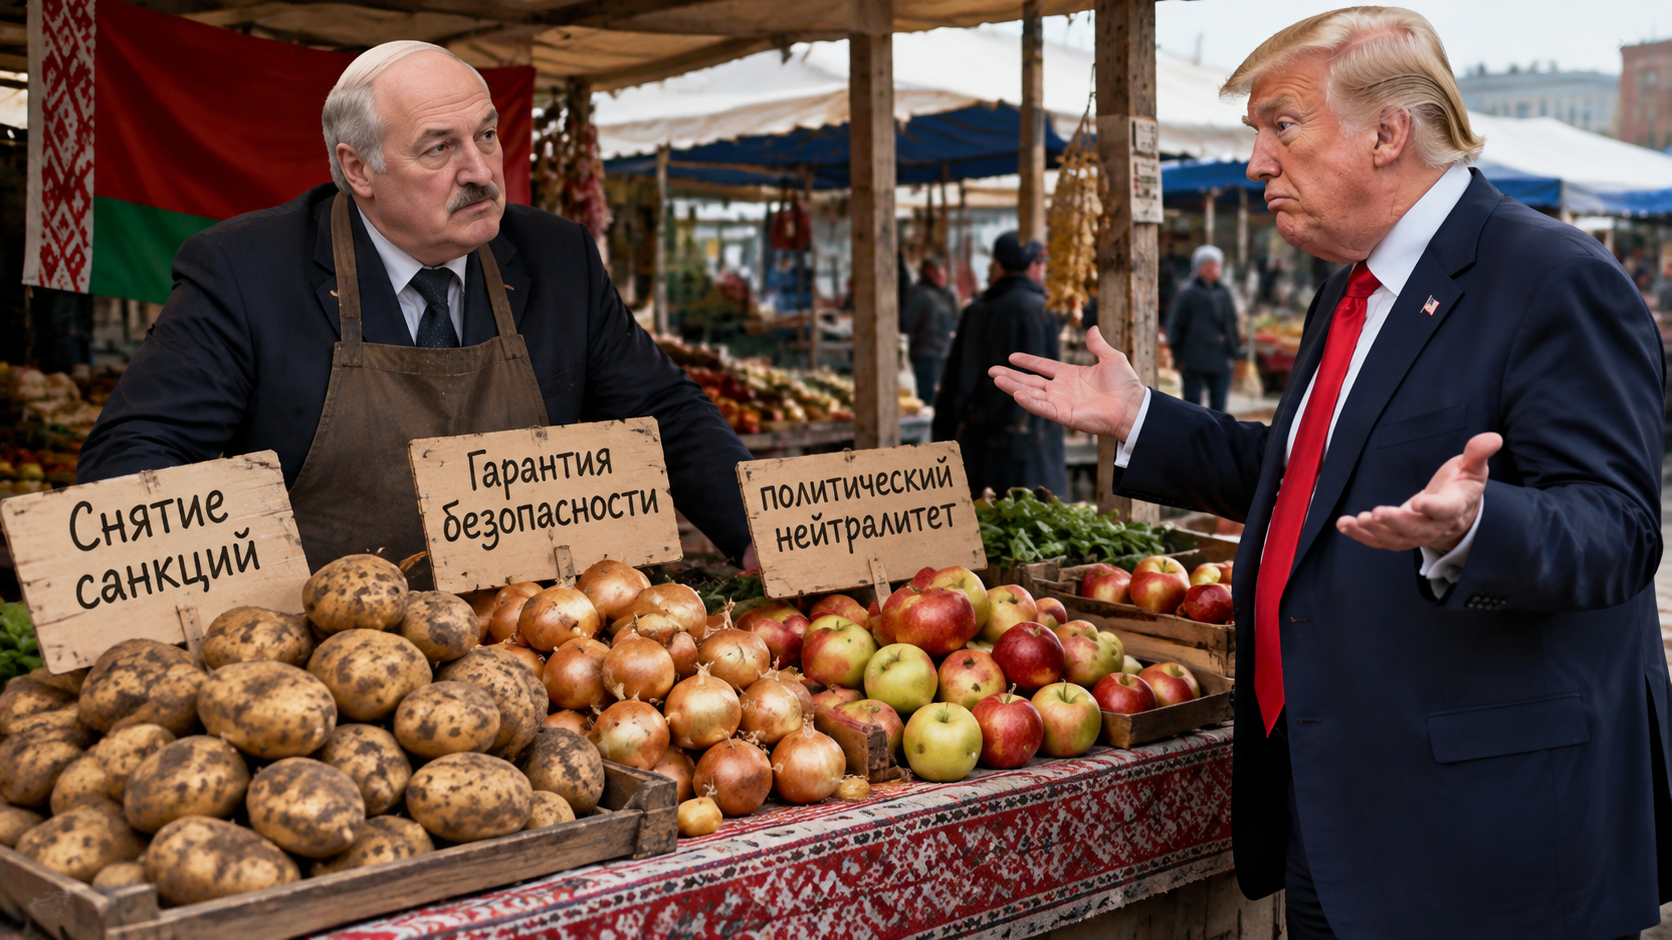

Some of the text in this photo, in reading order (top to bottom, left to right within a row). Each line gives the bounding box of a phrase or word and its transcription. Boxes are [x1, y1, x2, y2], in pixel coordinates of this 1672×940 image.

[467, 447, 613, 500] Гарантия
[760, 457, 953, 510] политический
[69, 489, 229, 551] Снятие
[442, 488, 659, 550] безопасности
[775, 502, 957, 554] нейтралитет
[76, 527, 260, 609] санкций
